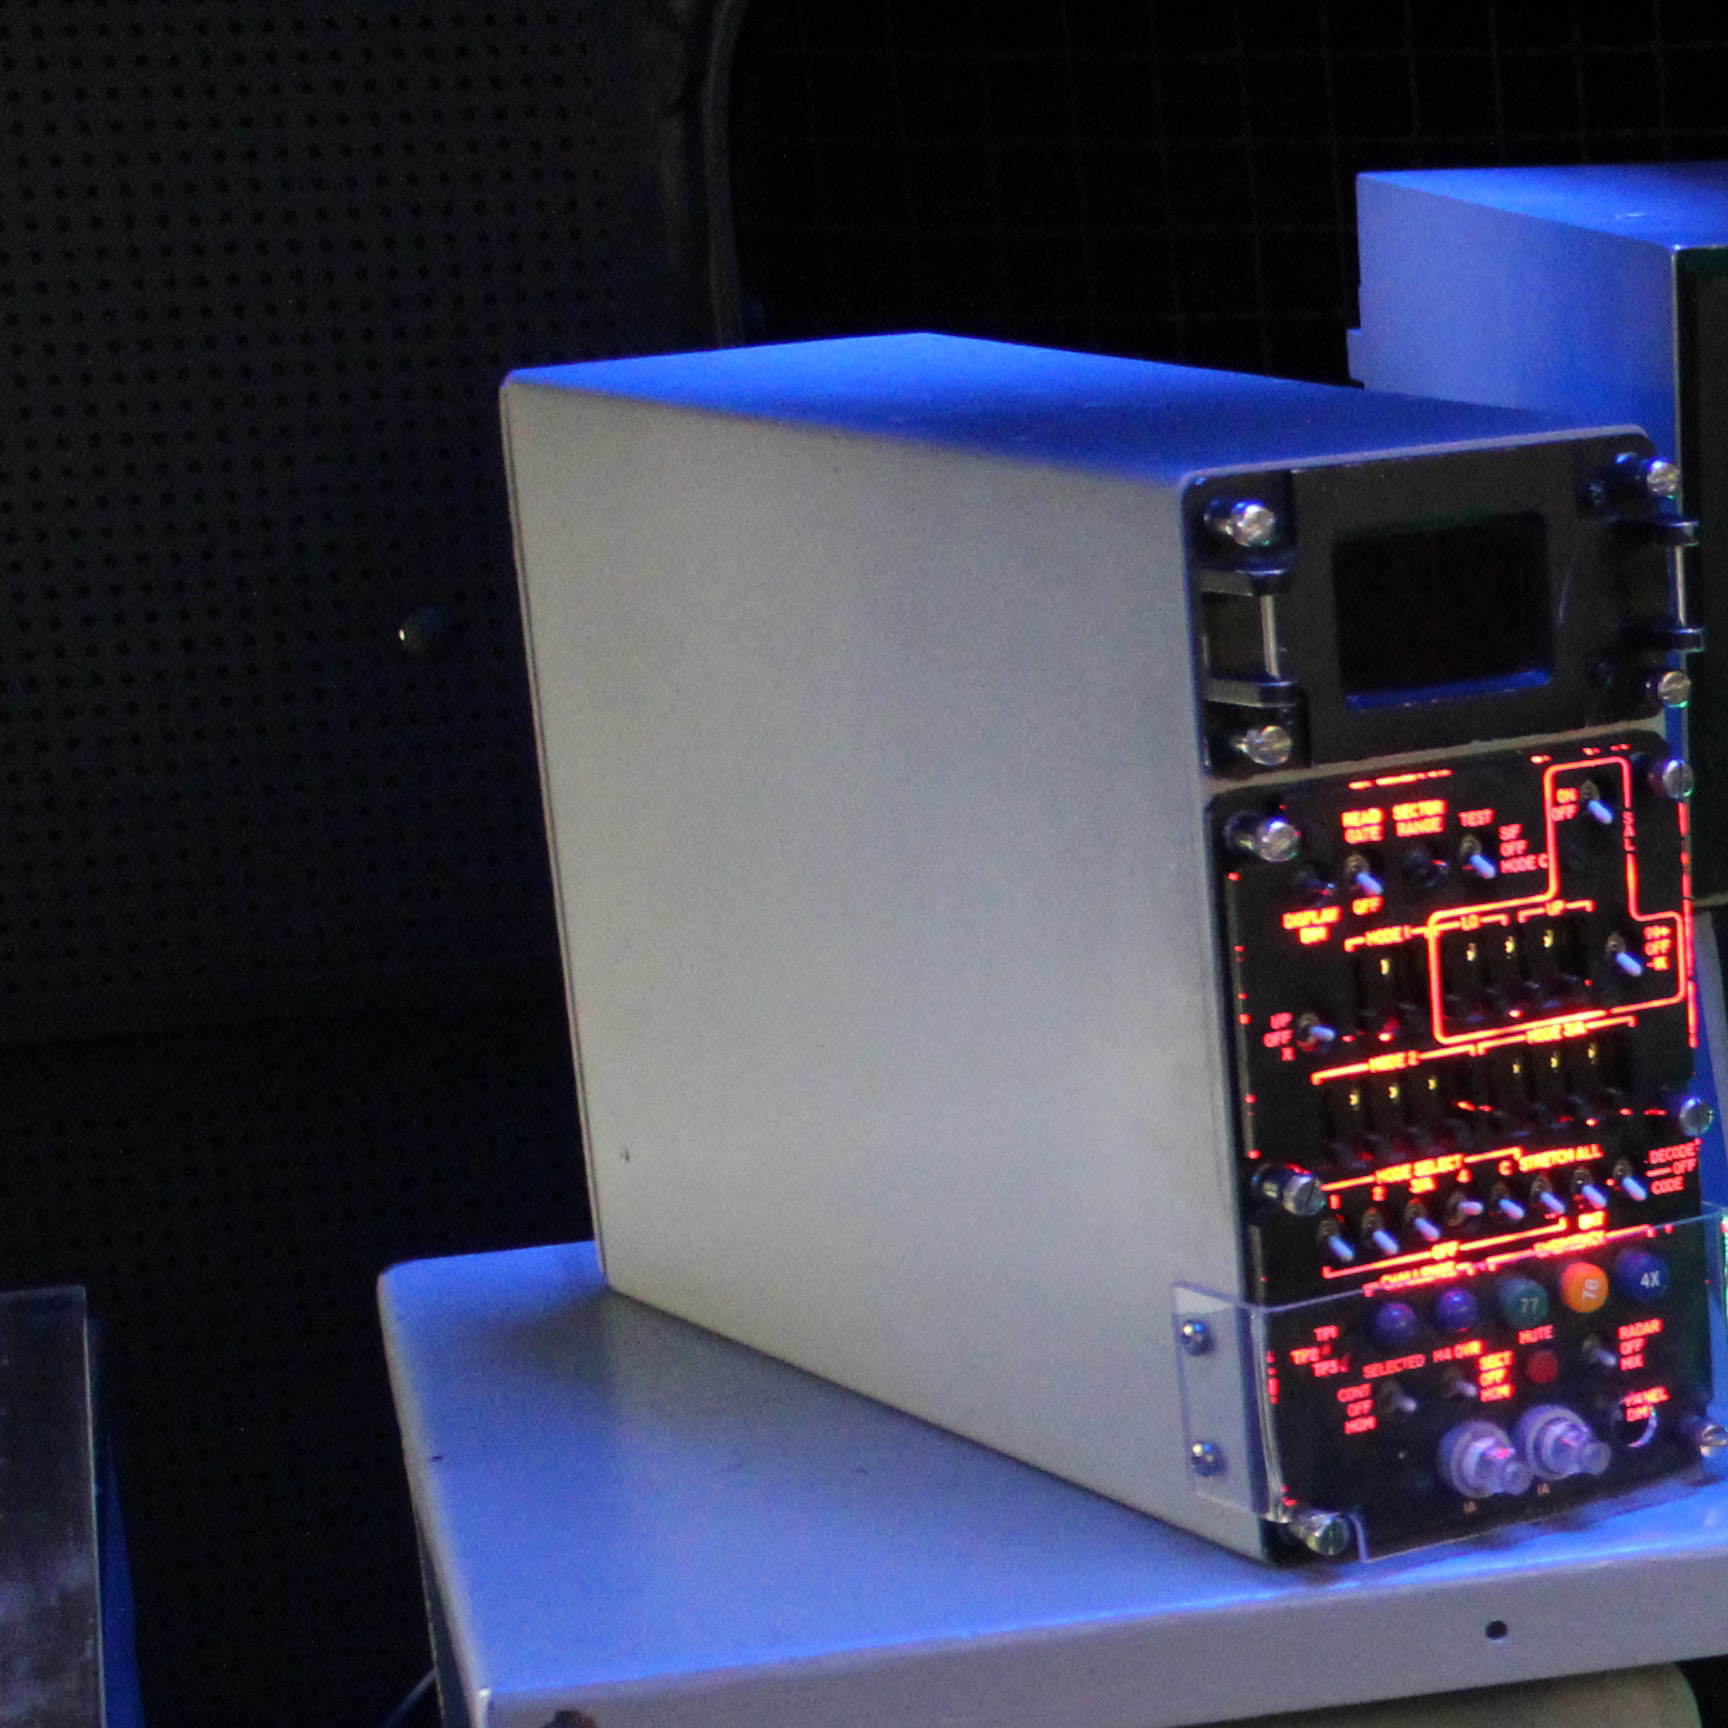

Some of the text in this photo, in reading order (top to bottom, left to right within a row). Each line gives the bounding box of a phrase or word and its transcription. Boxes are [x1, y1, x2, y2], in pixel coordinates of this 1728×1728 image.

[1458, 808, 1495, 828] TEST
[1552, 803, 1579, 822] OFF
[1500, 839, 1529, 858] OFF
[1500, 855, 1537, 874] MODE
[1351, 895, 1385, 916] OFF
[1365, 927, 1405, 948] MODE
[1643, 938, 1672, 957] OFF
[1262, 1028, 1294, 1048] OFF
[1525, 1024, 1562, 1044] MODE
[1368, 1052, 1407, 1073] MODE
[1517, 1143, 1604, 1173] STRETCH ALL
[1648, 1143, 1698, 1165] DECODE
[1375, 1154, 1466, 1185] MODE SELECT
[1671, 1158, 1699, 1175] OFF
[1650, 1176, 1686, 1195] CODE
[1430, 1240, 1461, 1260] OFF
[1640, 1270, 1661, 1289] 4X
[1517, 1324, 1554, 1344] MUTE
[1617, 1318, 1663, 1340] RADAR
[1618, 1337, 1646, 1356] OFF
[1362, 1353, 1426, 1380] SELECTED
[1478, 1350, 1514, 1370] SECT
[1478, 1367, 1508, 1386] OFF
[1336, 1382, 1373, 1402] CONT
[1346, 1399, 1374, 1418] OFF
